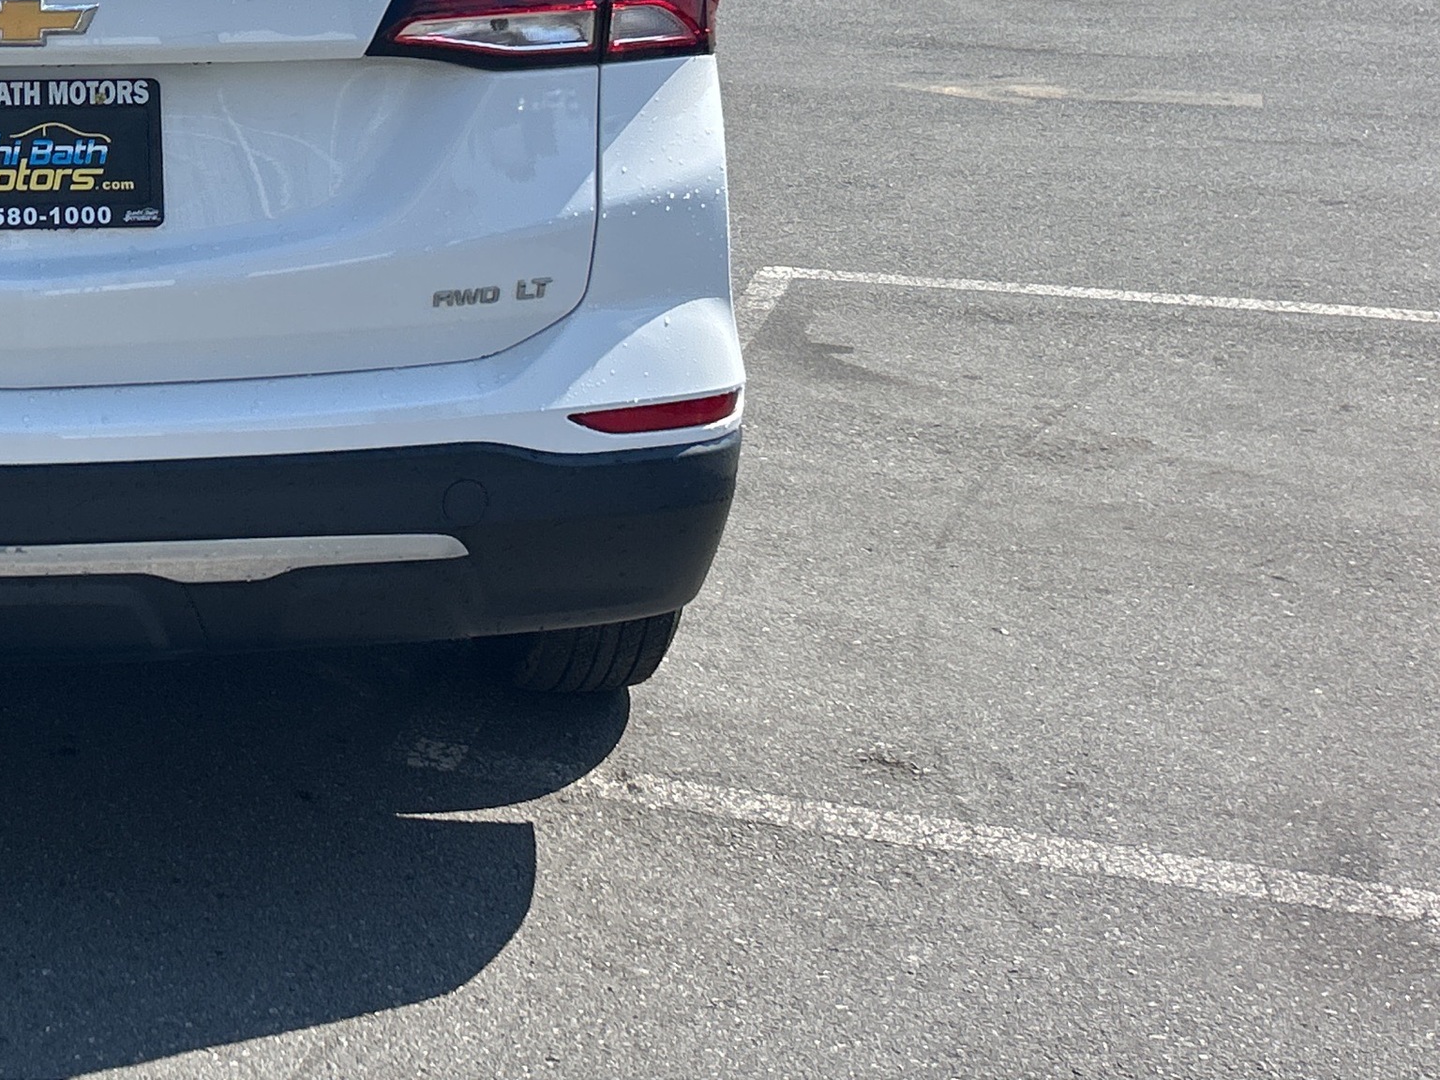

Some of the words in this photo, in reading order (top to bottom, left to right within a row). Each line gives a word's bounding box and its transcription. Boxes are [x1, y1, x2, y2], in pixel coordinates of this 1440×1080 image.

[48, 80, 149, 105] MOTORS
[28, 138, 108, 166] Bath
[433, 285, 500, 308] AWD
[516, 276, 553, 301] LT
